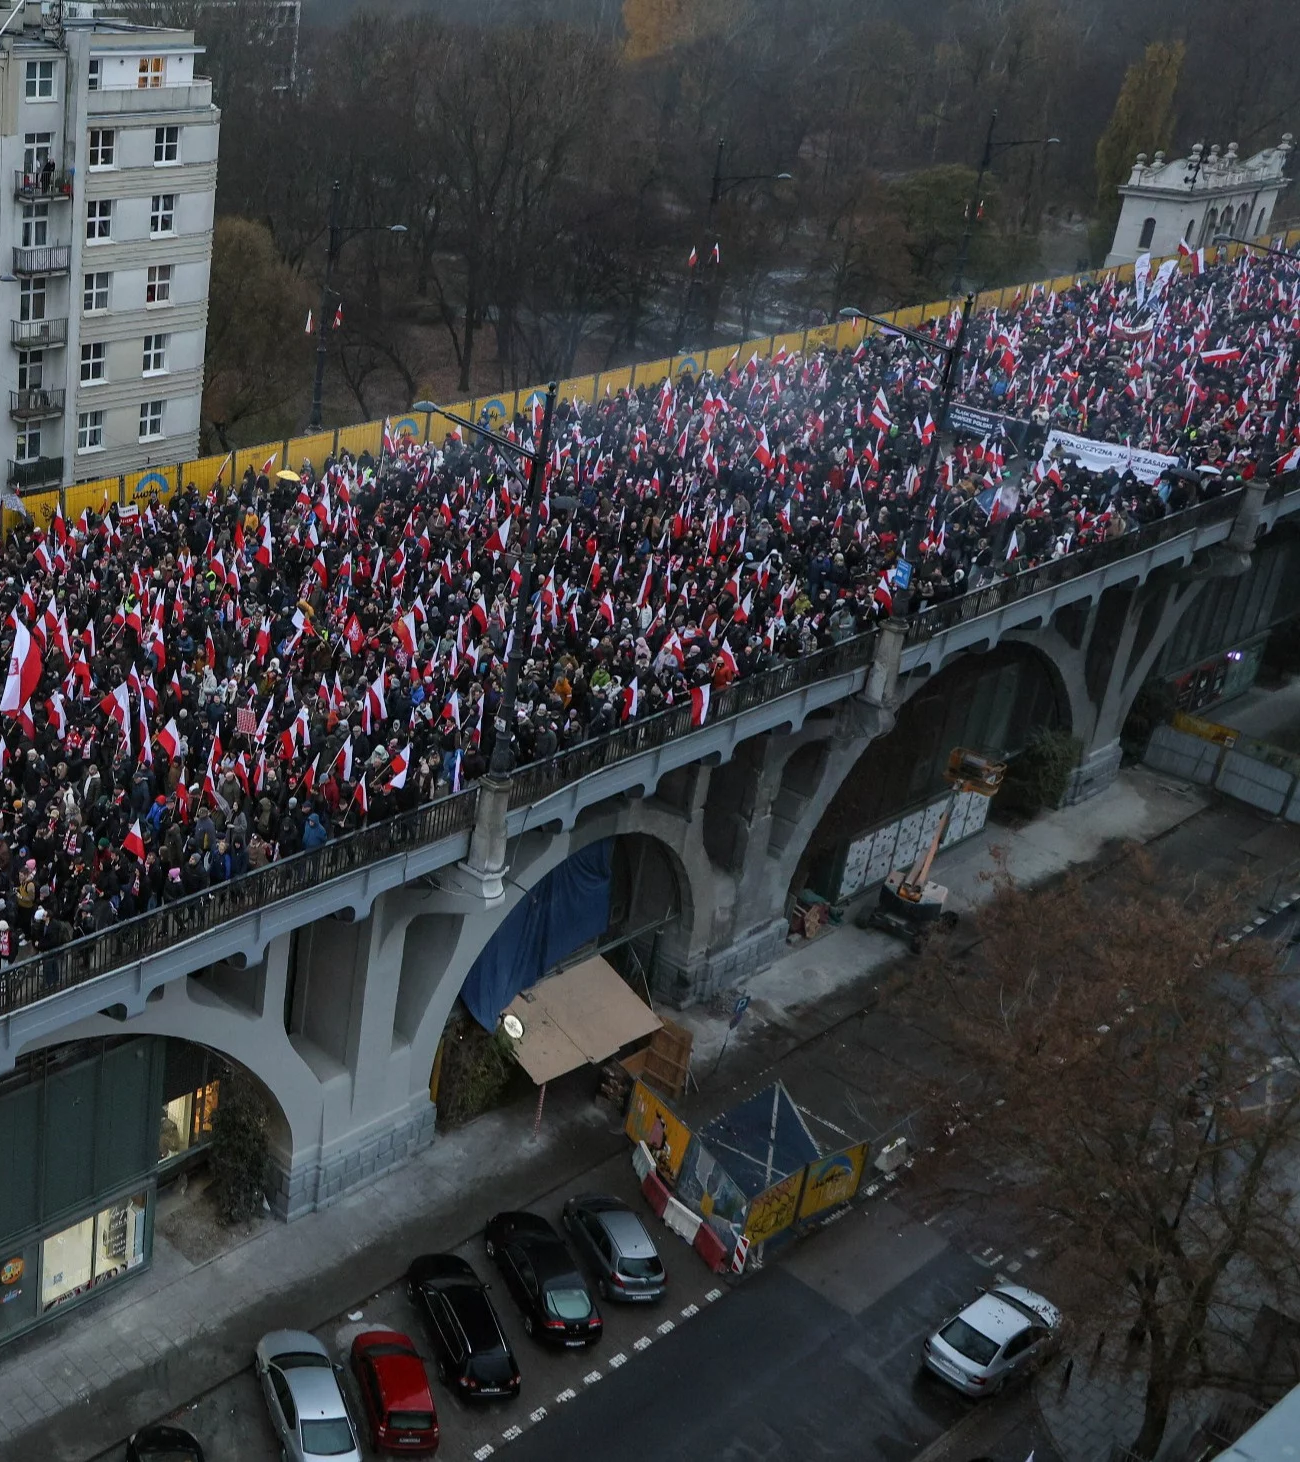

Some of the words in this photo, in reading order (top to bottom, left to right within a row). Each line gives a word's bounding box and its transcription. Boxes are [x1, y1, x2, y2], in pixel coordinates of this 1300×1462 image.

[973, 419, 993, 429] POLSKI
[1052, 437, 1074, 447] NASZA
[1076, 444, 1112, 456] OJCZYZNA
[1118, 452, 1141, 463] NAZE
[736, 998, 748, 1011] P
